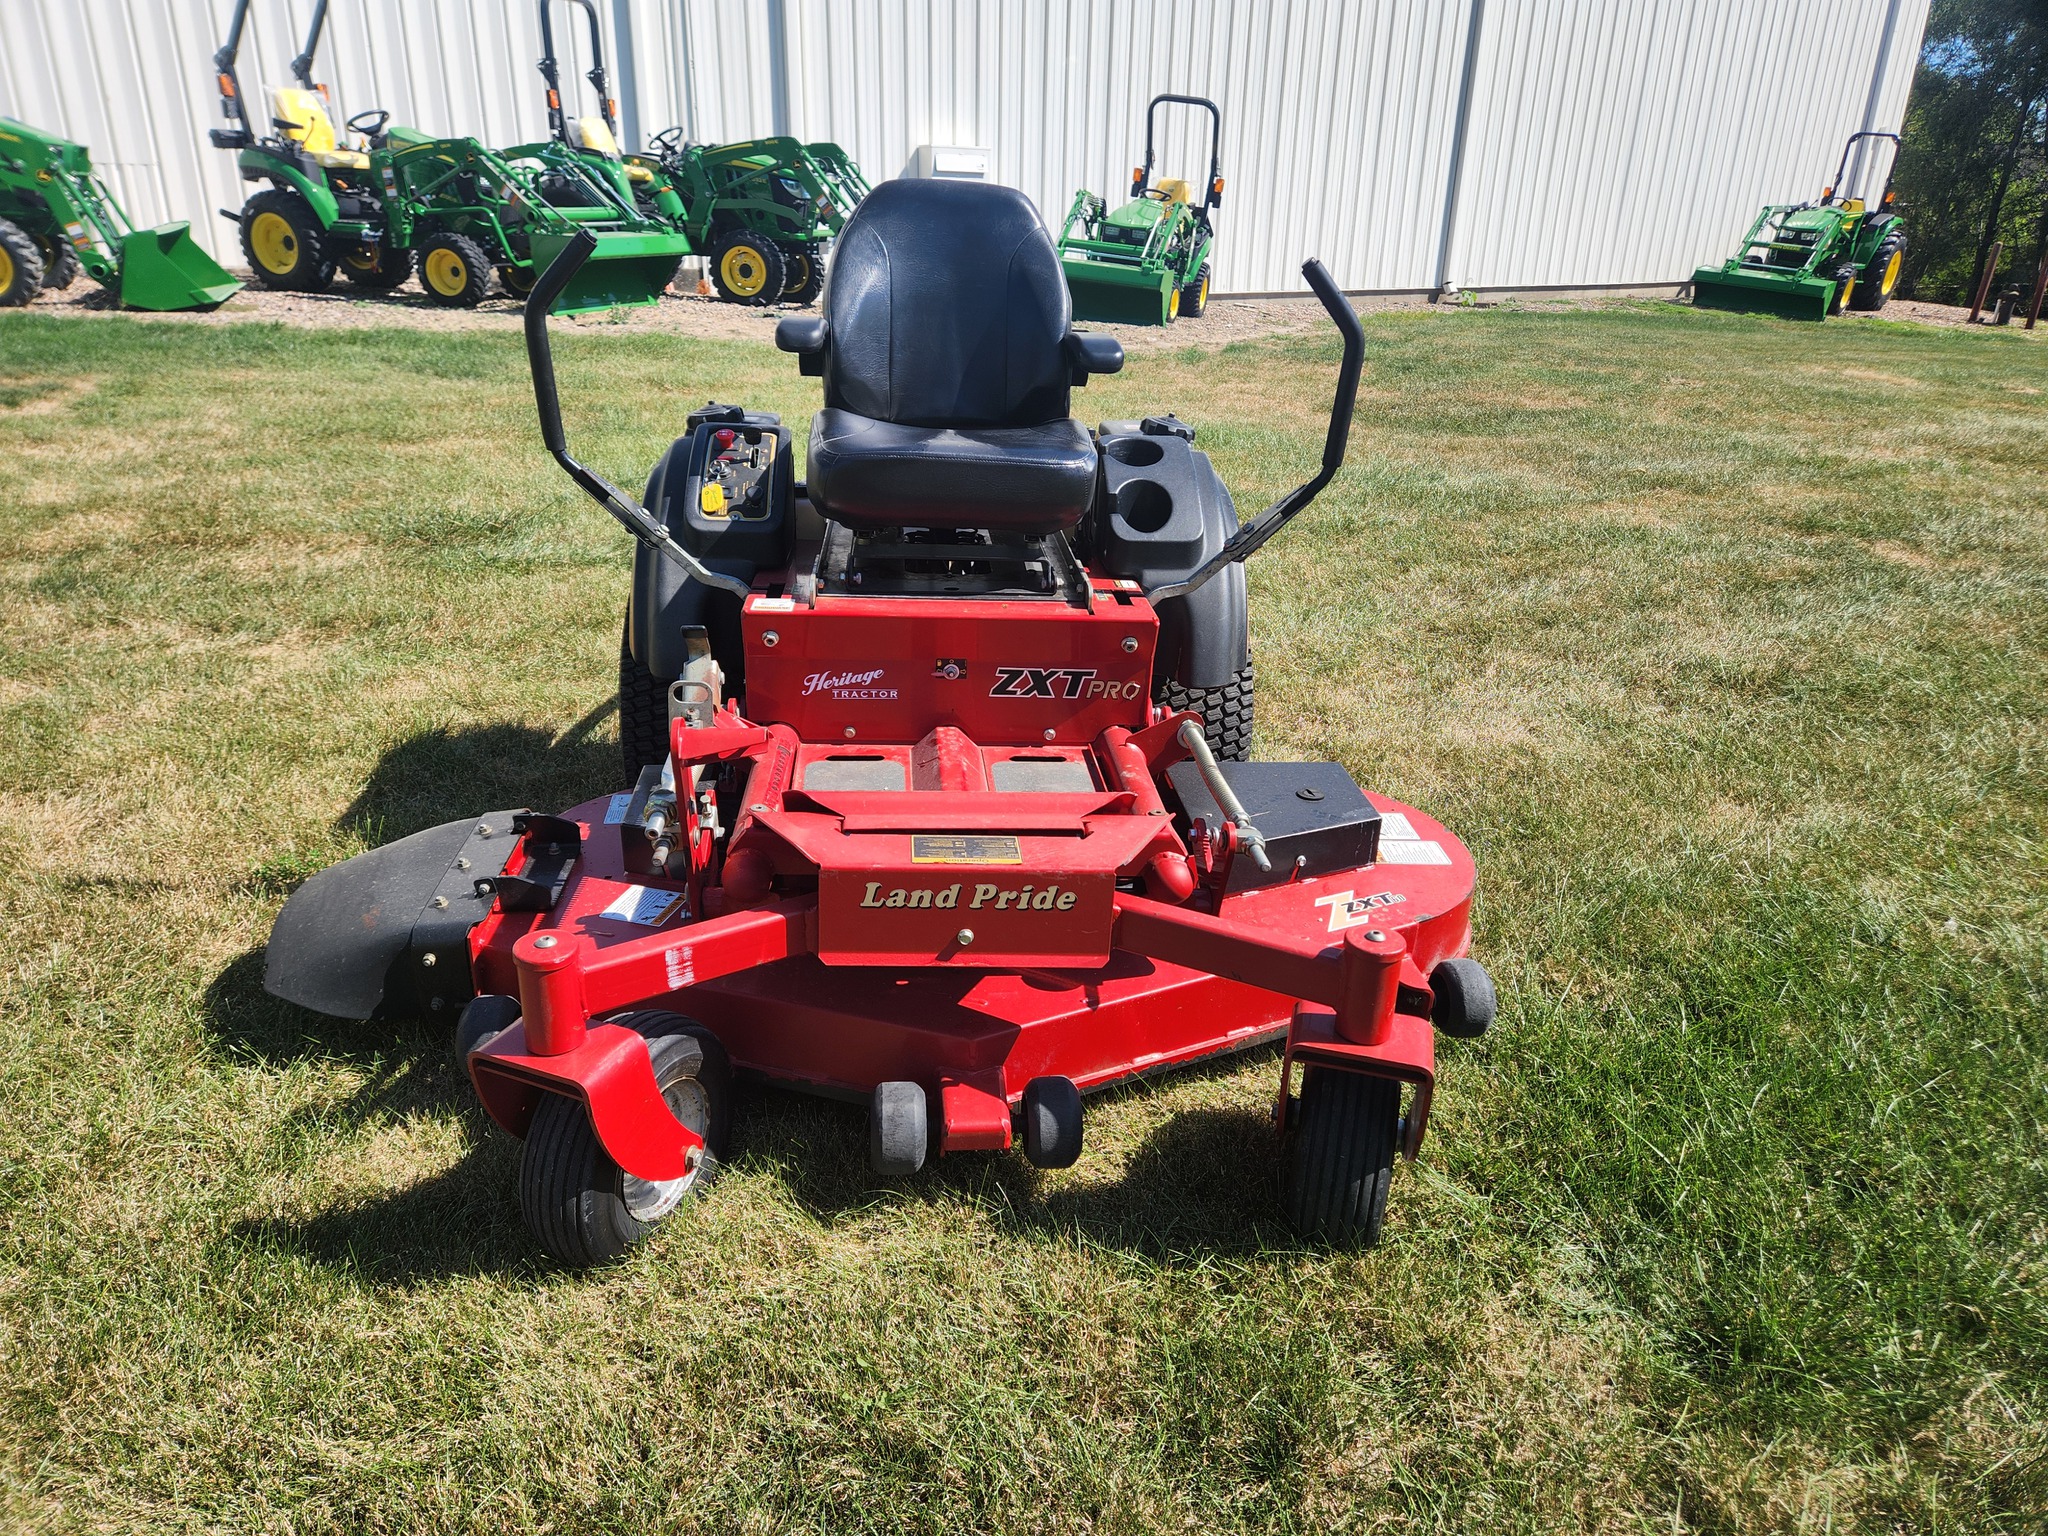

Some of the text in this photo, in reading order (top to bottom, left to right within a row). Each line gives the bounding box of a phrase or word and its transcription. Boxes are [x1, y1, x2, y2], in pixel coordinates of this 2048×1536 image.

[802, 669, 884, 696] Heritage
[832, 690, 898, 699] TRACTOR
[989, 667, 1141, 700] ZXT PRO
[860, 882, 1079, 911] Land Pride
